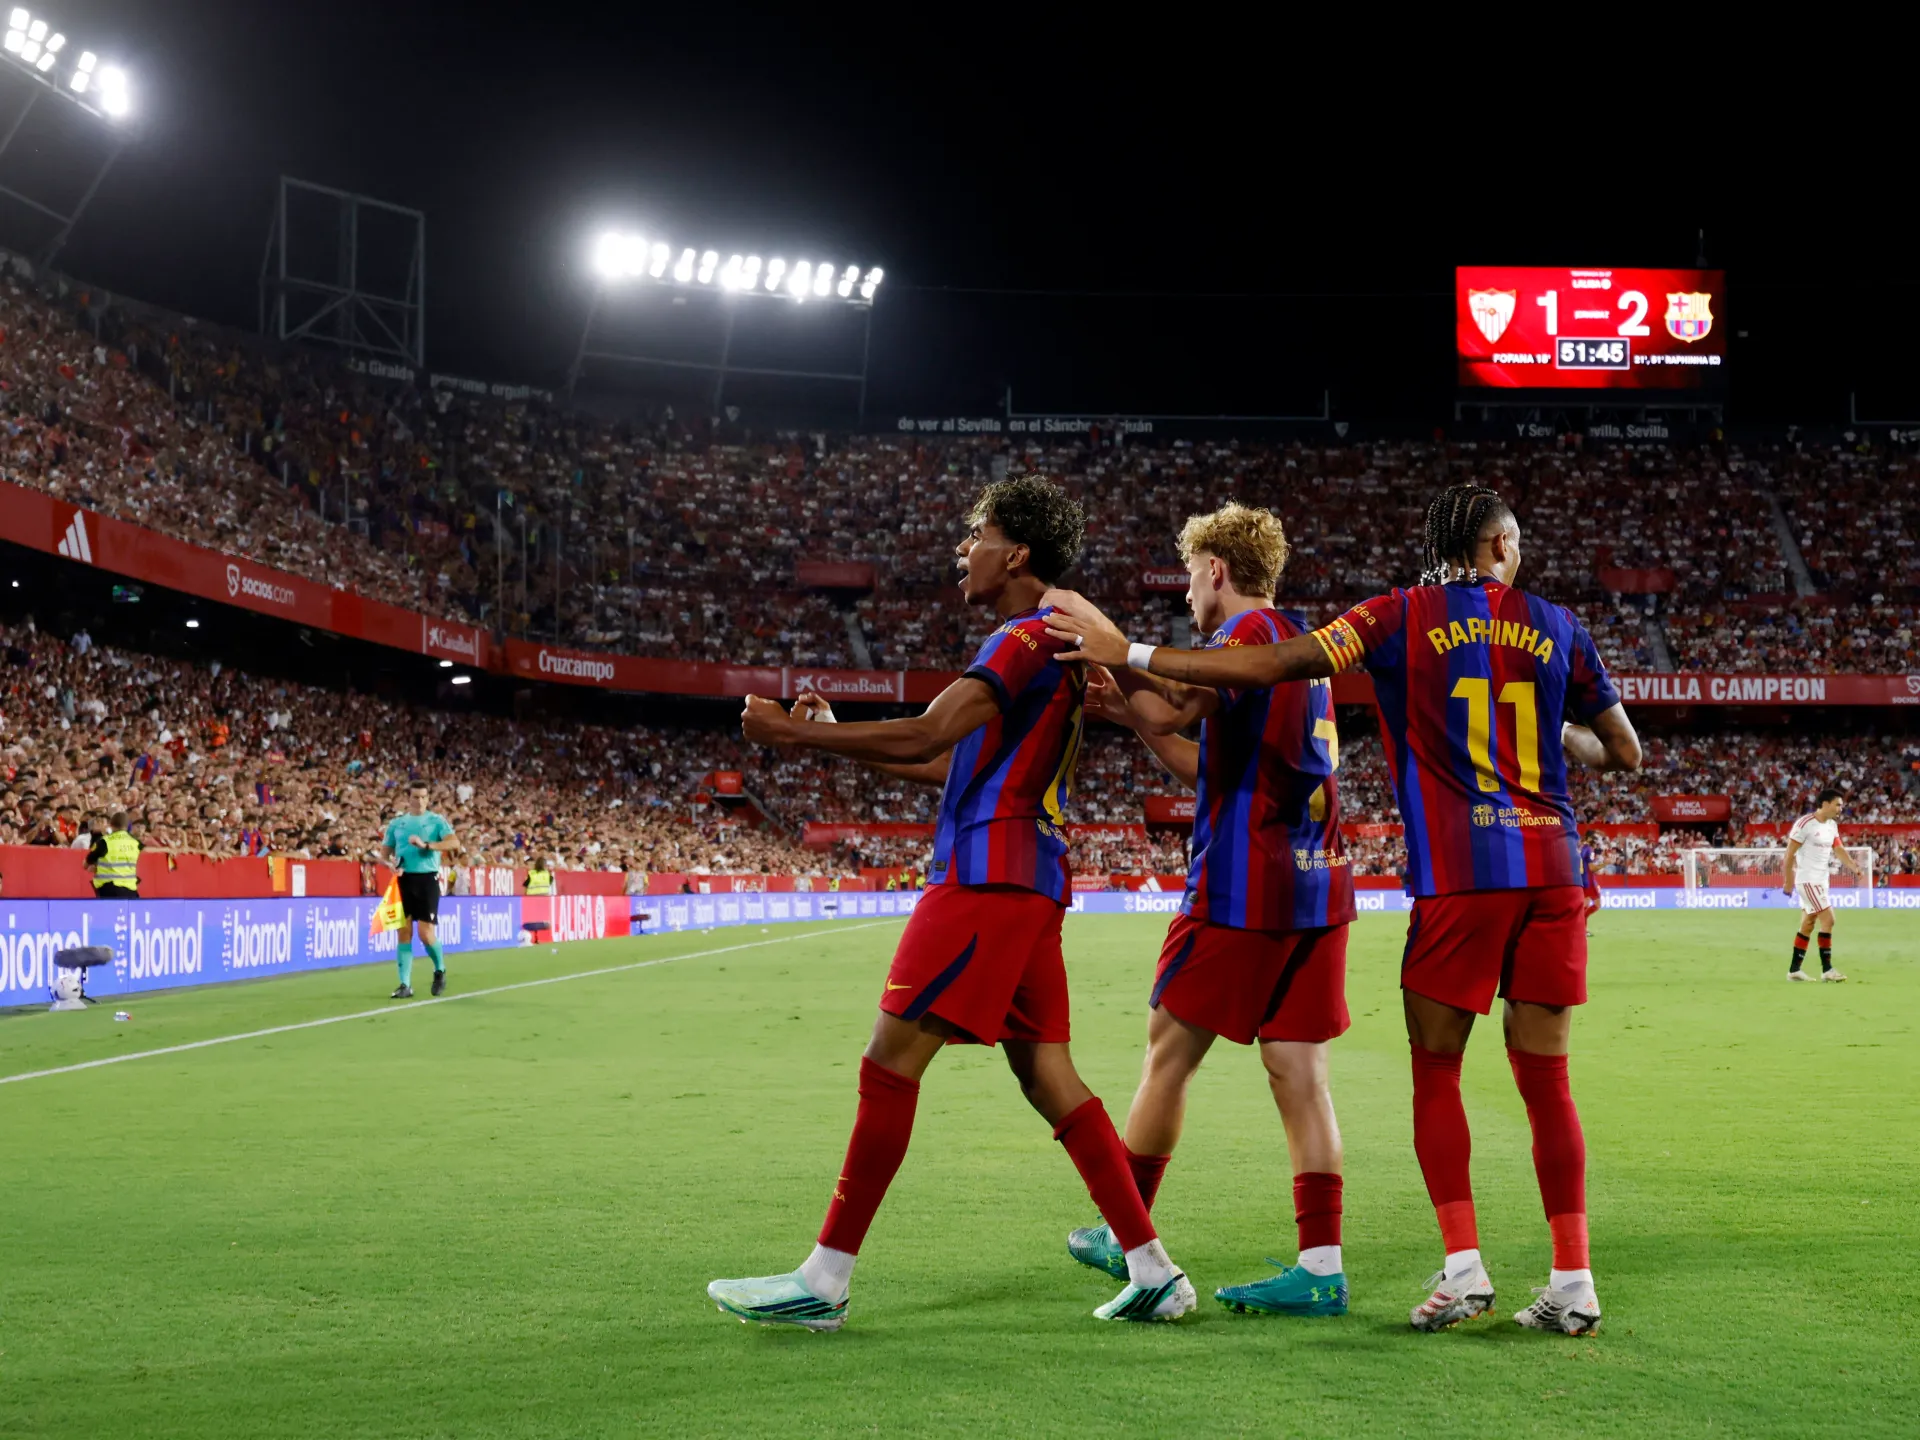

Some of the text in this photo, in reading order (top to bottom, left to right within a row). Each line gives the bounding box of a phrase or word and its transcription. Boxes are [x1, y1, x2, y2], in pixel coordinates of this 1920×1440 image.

[1537, 290, 1557, 335] 1
[1617, 290, 1650, 336] 2
[1560, 342, 1623, 362] 51:45
[898, 417, 1001, 433] de ver al Sevilla
[1009, 420, 1026, 432] en
[1029, 418, 1041, 433] el
[1044, 417, 1092, 433] Sánche
[1516, 423, 1525, 437] Y
[1626, 423, 1669, 438] Sevilla
[1354, 605, 1376, 626] dea
[1427, 617, 1555, 665] RAPHINHA
[538, 650, 615, 681] Cruzcampo
[817, 676, 895, 694] CaixaBank
[1608, 677, 1826, 700] SEVILLA CAMPEON
[1450, 677, 1541, 793] 11
[1498, 807, 1532, 817] BARÇA
[1499, 816, 1561, 828] FOUNDATION
[1672, 808, 1680, 816] TE
[1136, 895, 1182, 912] biom
[477, 903, 513, 943] biomol
[551, 895, 594, 942] LALIGA
[233, 907, 292, 969] biomol
[314, 906, 360, 959] biomol
[130, 910, 203, 979] biomol
